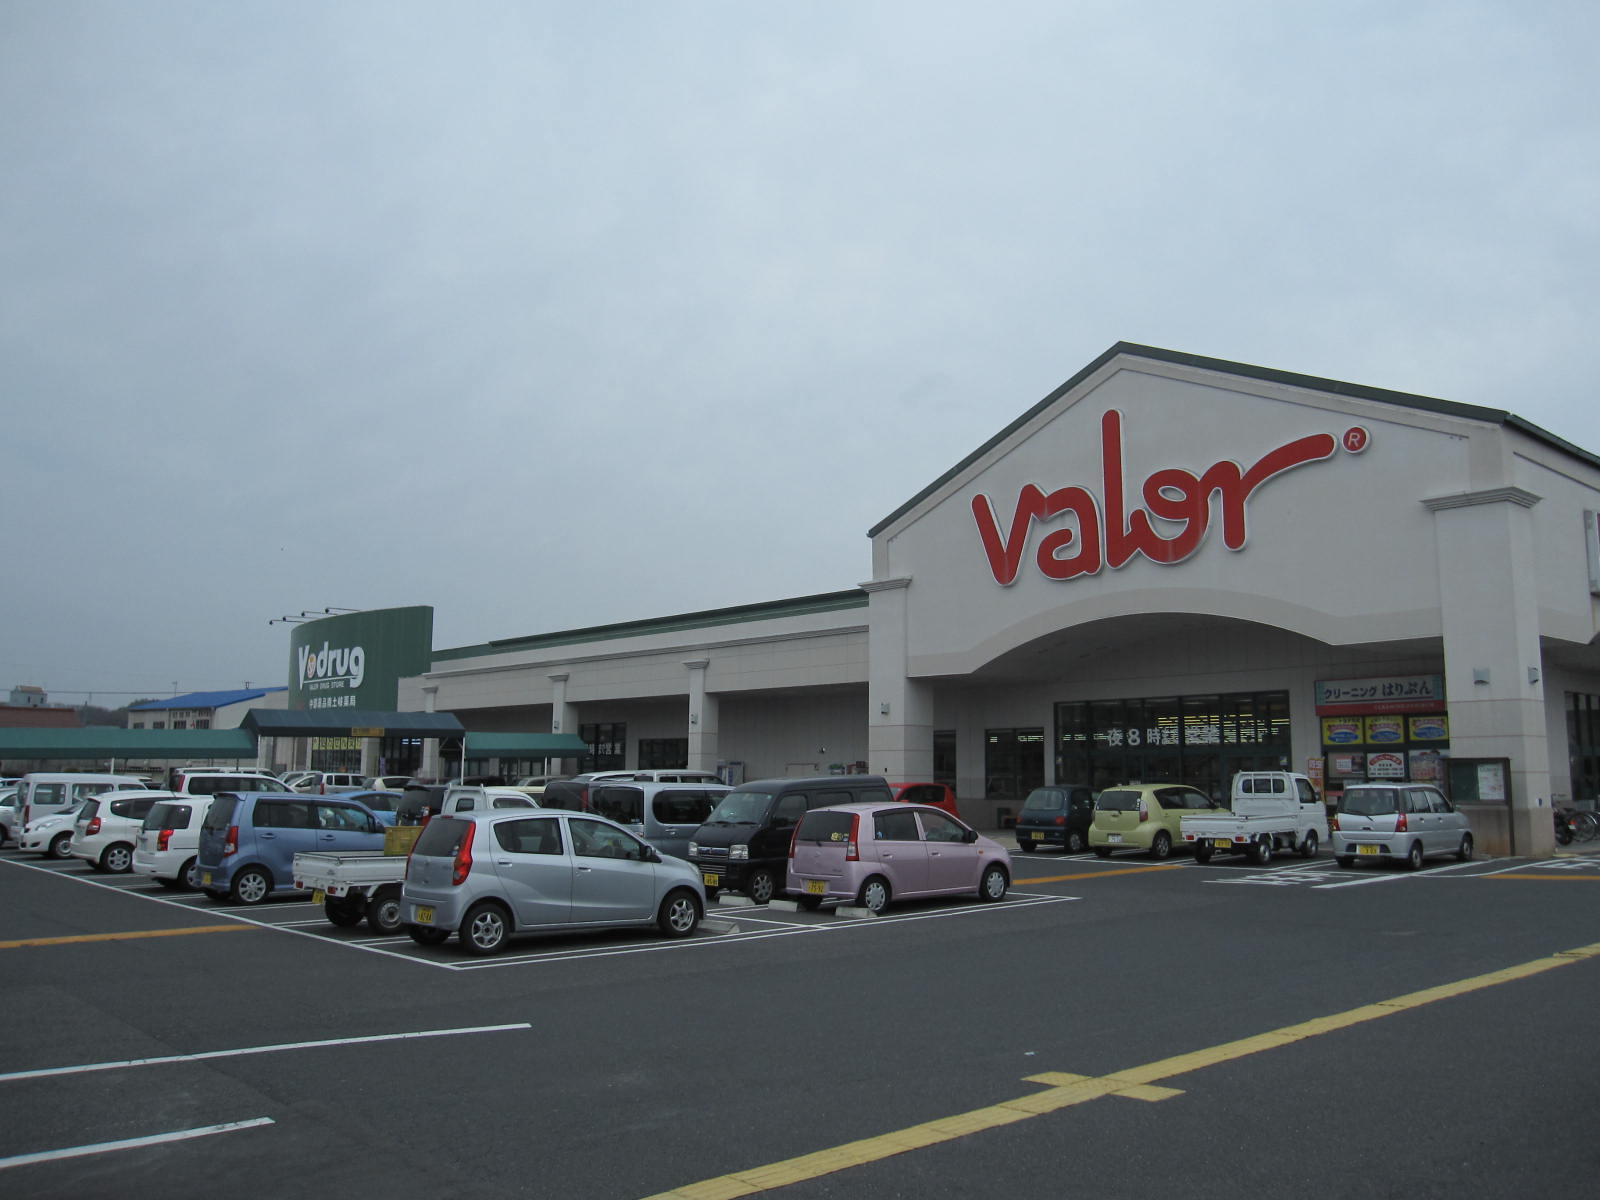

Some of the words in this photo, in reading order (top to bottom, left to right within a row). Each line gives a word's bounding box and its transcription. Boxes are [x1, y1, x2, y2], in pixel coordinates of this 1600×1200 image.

[971, 408, 1336, 587] valor
[1324, 685, 1377, 699] クリーニング
